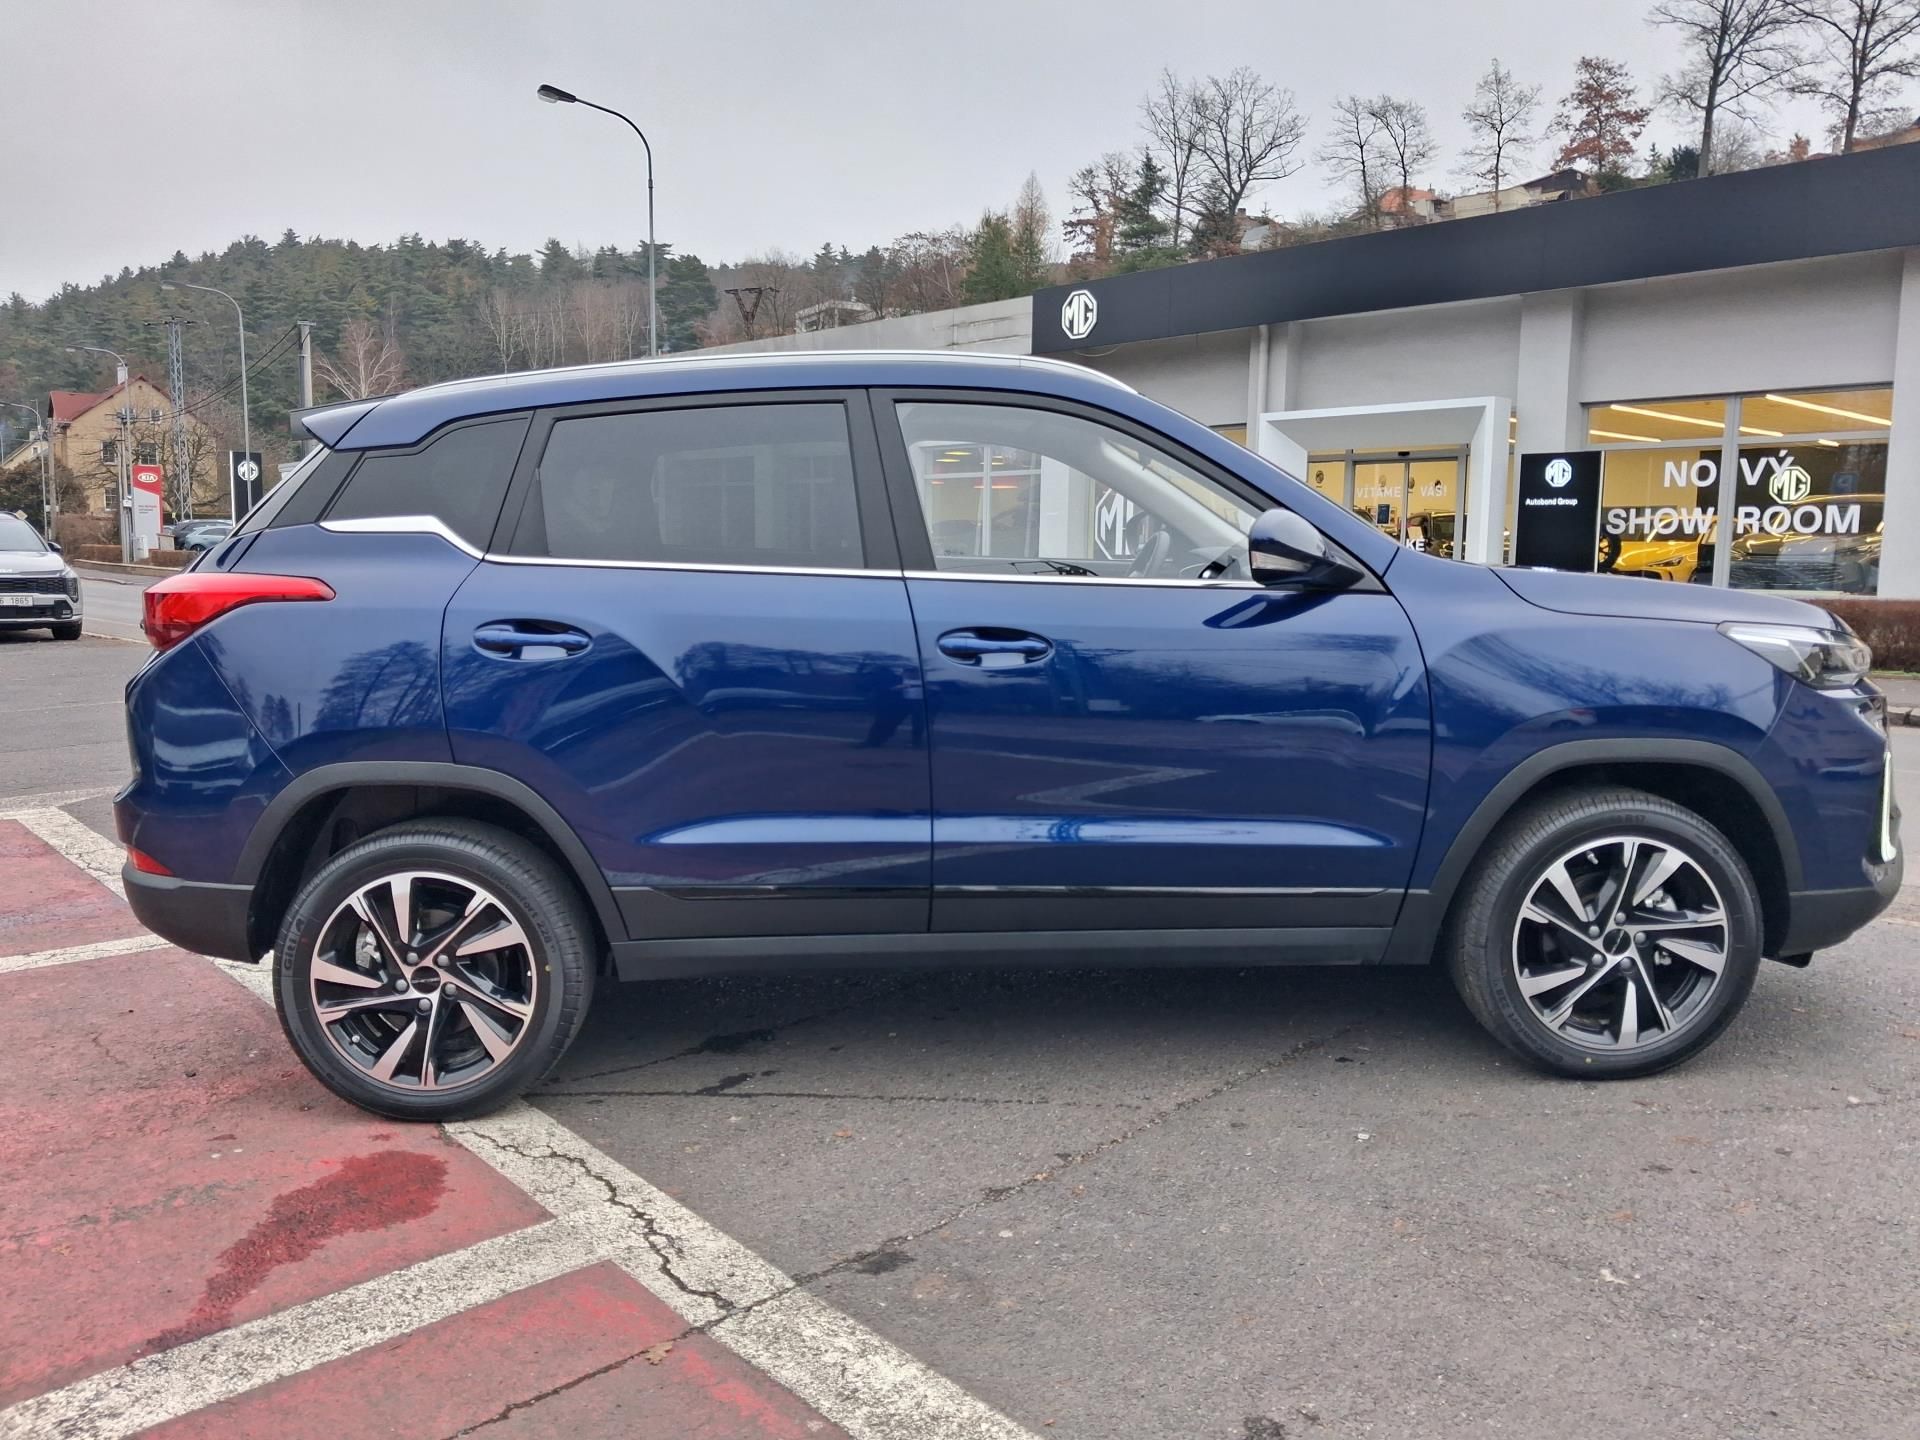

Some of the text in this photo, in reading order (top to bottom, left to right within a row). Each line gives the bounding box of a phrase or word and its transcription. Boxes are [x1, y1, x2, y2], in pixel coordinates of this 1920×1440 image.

[1063, 291, 1095, 337] MG
[140, 474, 156, 482] KIA
[239, 462, 257, 479] MG
[1546, 460, 1571, 486] MG
[1771, 467, 1809, 502] MG
[1557, 497, 1578, 506] Group
[1606, 504, 1861, 535] SHOW ROOM
